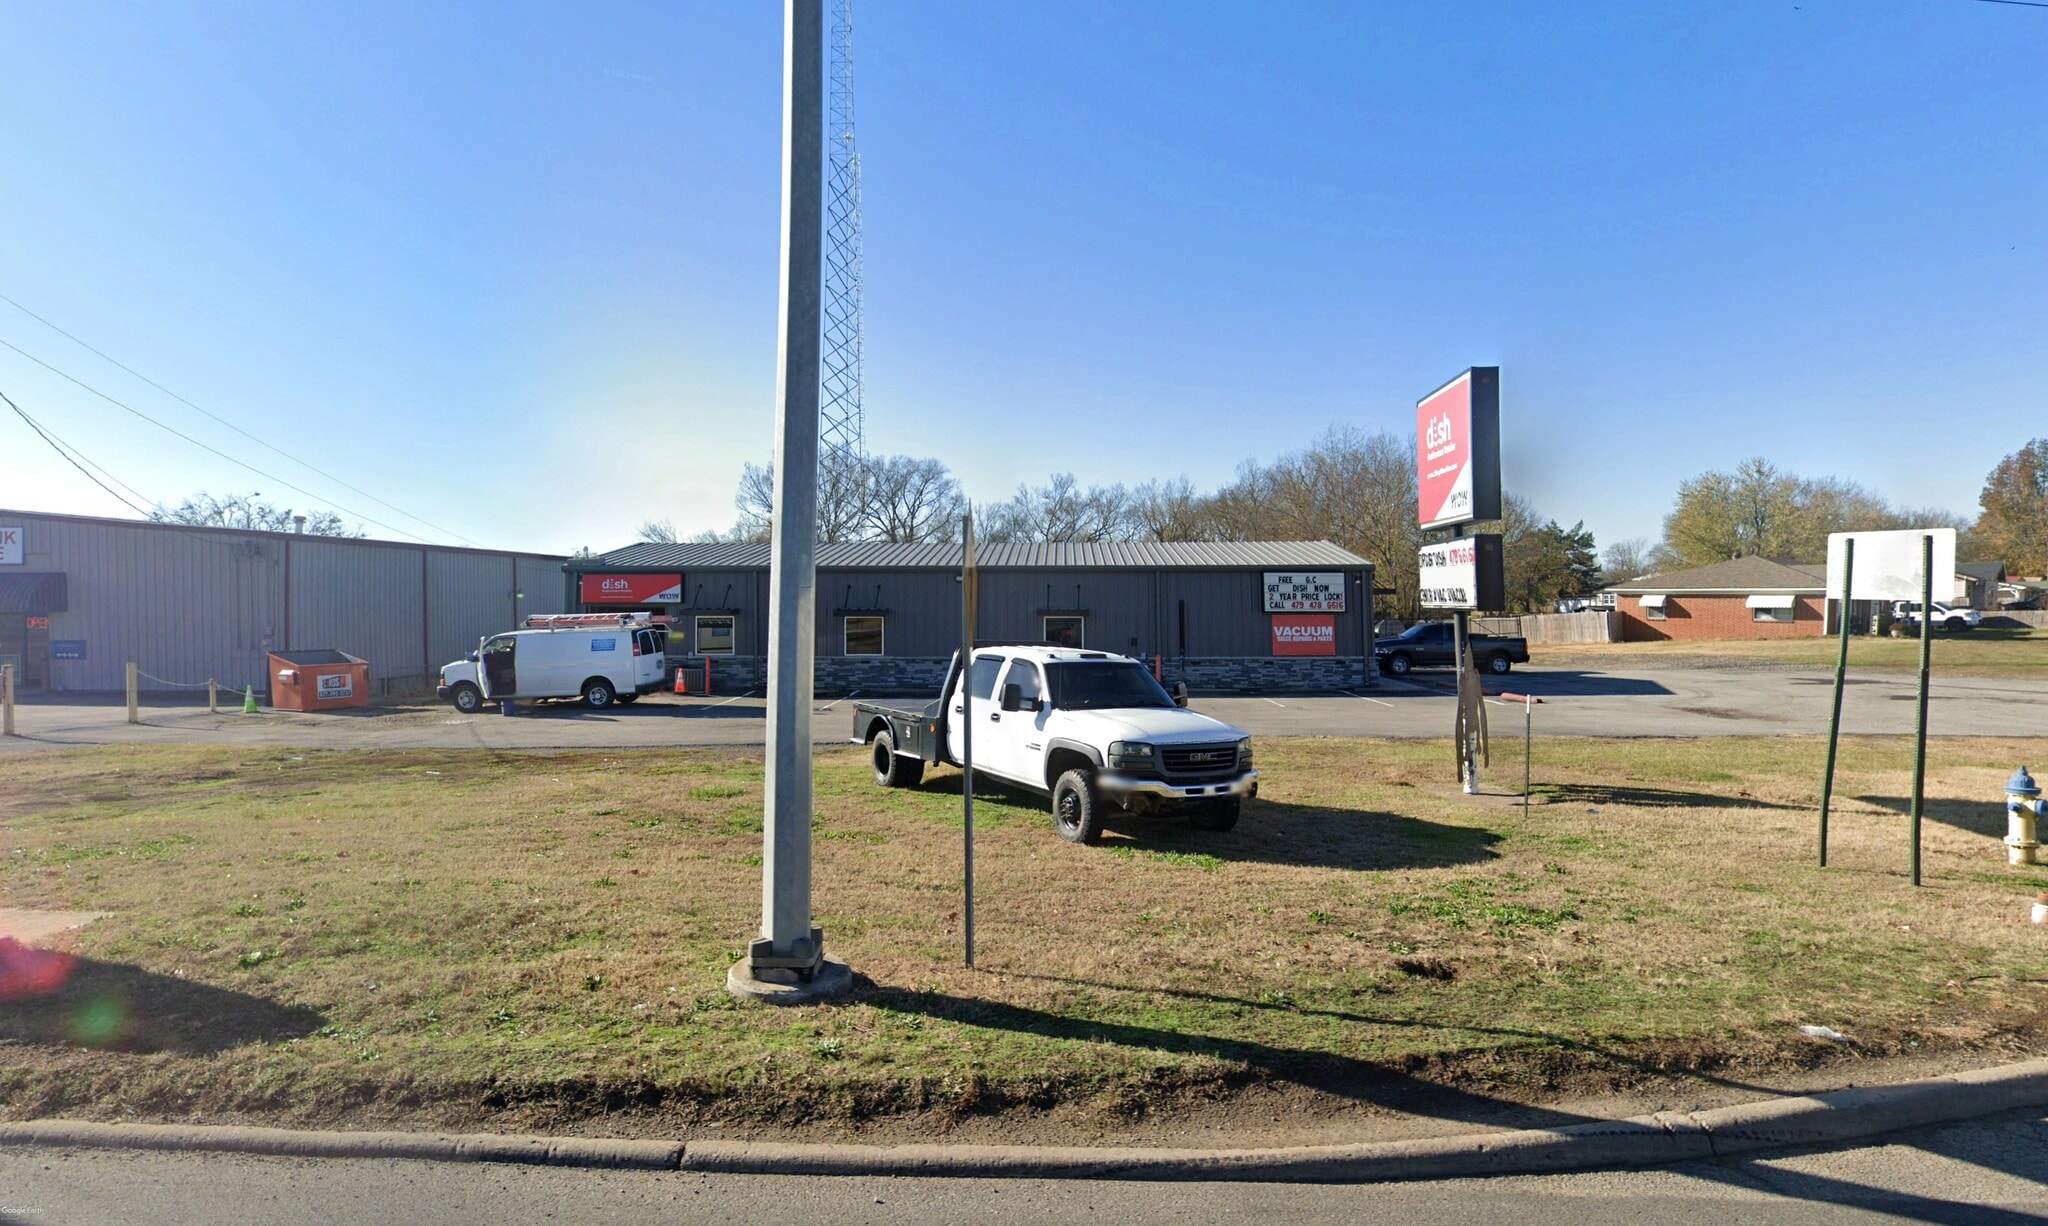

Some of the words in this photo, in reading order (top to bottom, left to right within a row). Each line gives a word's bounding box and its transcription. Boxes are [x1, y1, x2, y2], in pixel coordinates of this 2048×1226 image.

[1426, 411, 1452, 450] dish
[601, 578, 628, 589] dish
[1278, 576, 1293, 584] FREE
[1269, 593, 1274, 601] 2
[1279, 593, 1297, 601] YEAR
[1301, 593, 1320, 601] PRICE
[1291, 601, 1305, 609] 479
[1309, 601, 1322, 609] 478
[1273, 626, 1333, 636] VACUUM
[1189, 752, 1218, 762] GMC
